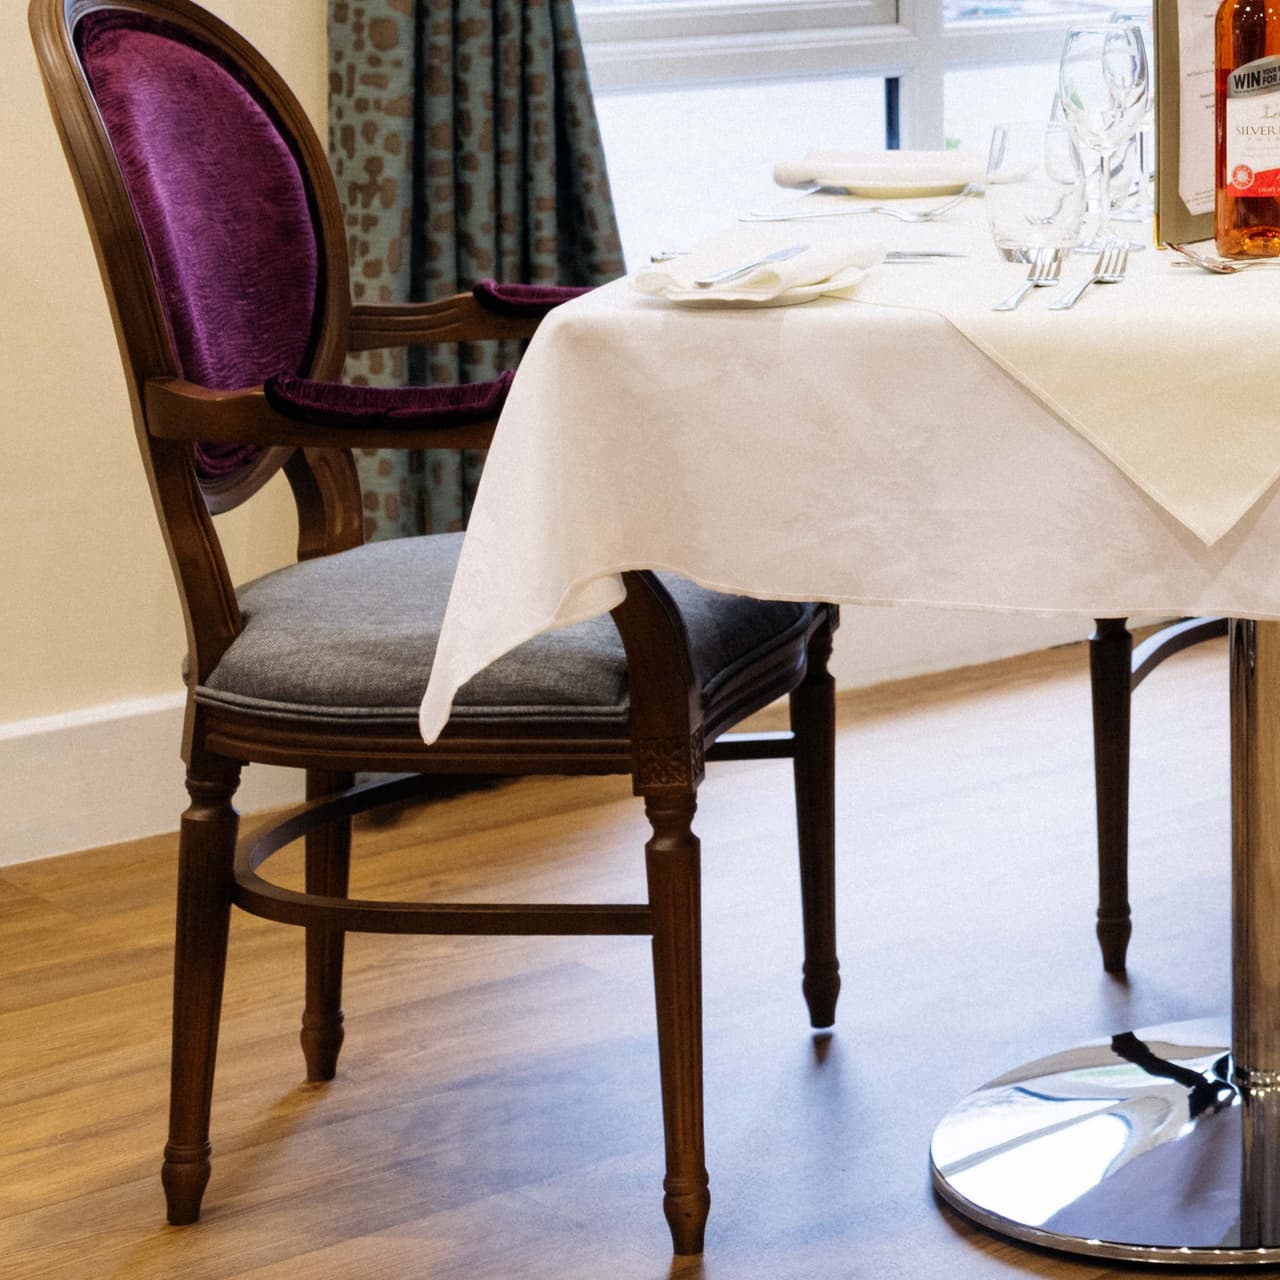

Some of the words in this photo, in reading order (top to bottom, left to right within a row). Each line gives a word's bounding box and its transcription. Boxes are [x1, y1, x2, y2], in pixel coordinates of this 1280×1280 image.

[1233, 71, 1260, 89] WIN
[1263, 75, 1277, 85] FOR
[1235, 126, 1276, 135] SILVER
